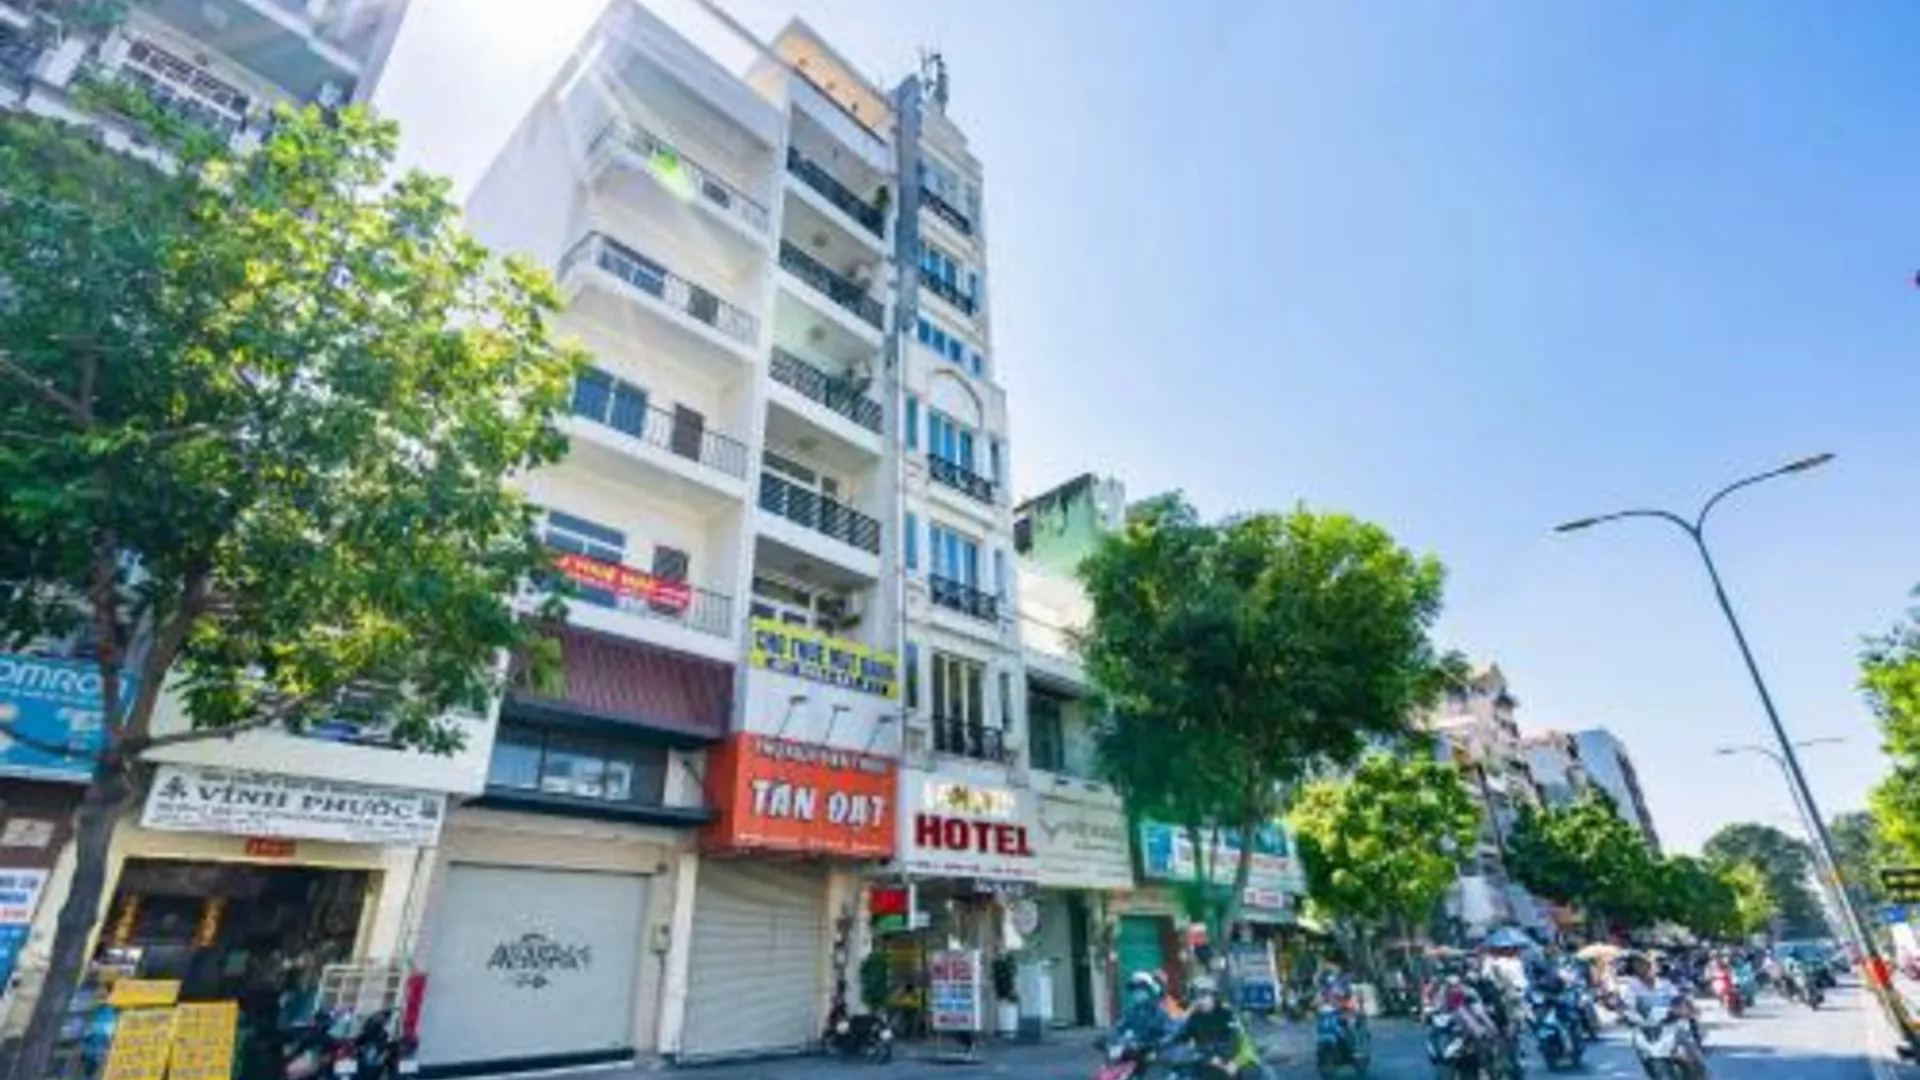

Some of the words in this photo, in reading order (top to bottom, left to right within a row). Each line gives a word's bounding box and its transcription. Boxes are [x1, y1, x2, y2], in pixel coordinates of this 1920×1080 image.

[752, 776, 818, 820] TÂN
[828, 790, 886, 831] ĐẠT
[915, 813, 1033, 857] HOTEL
